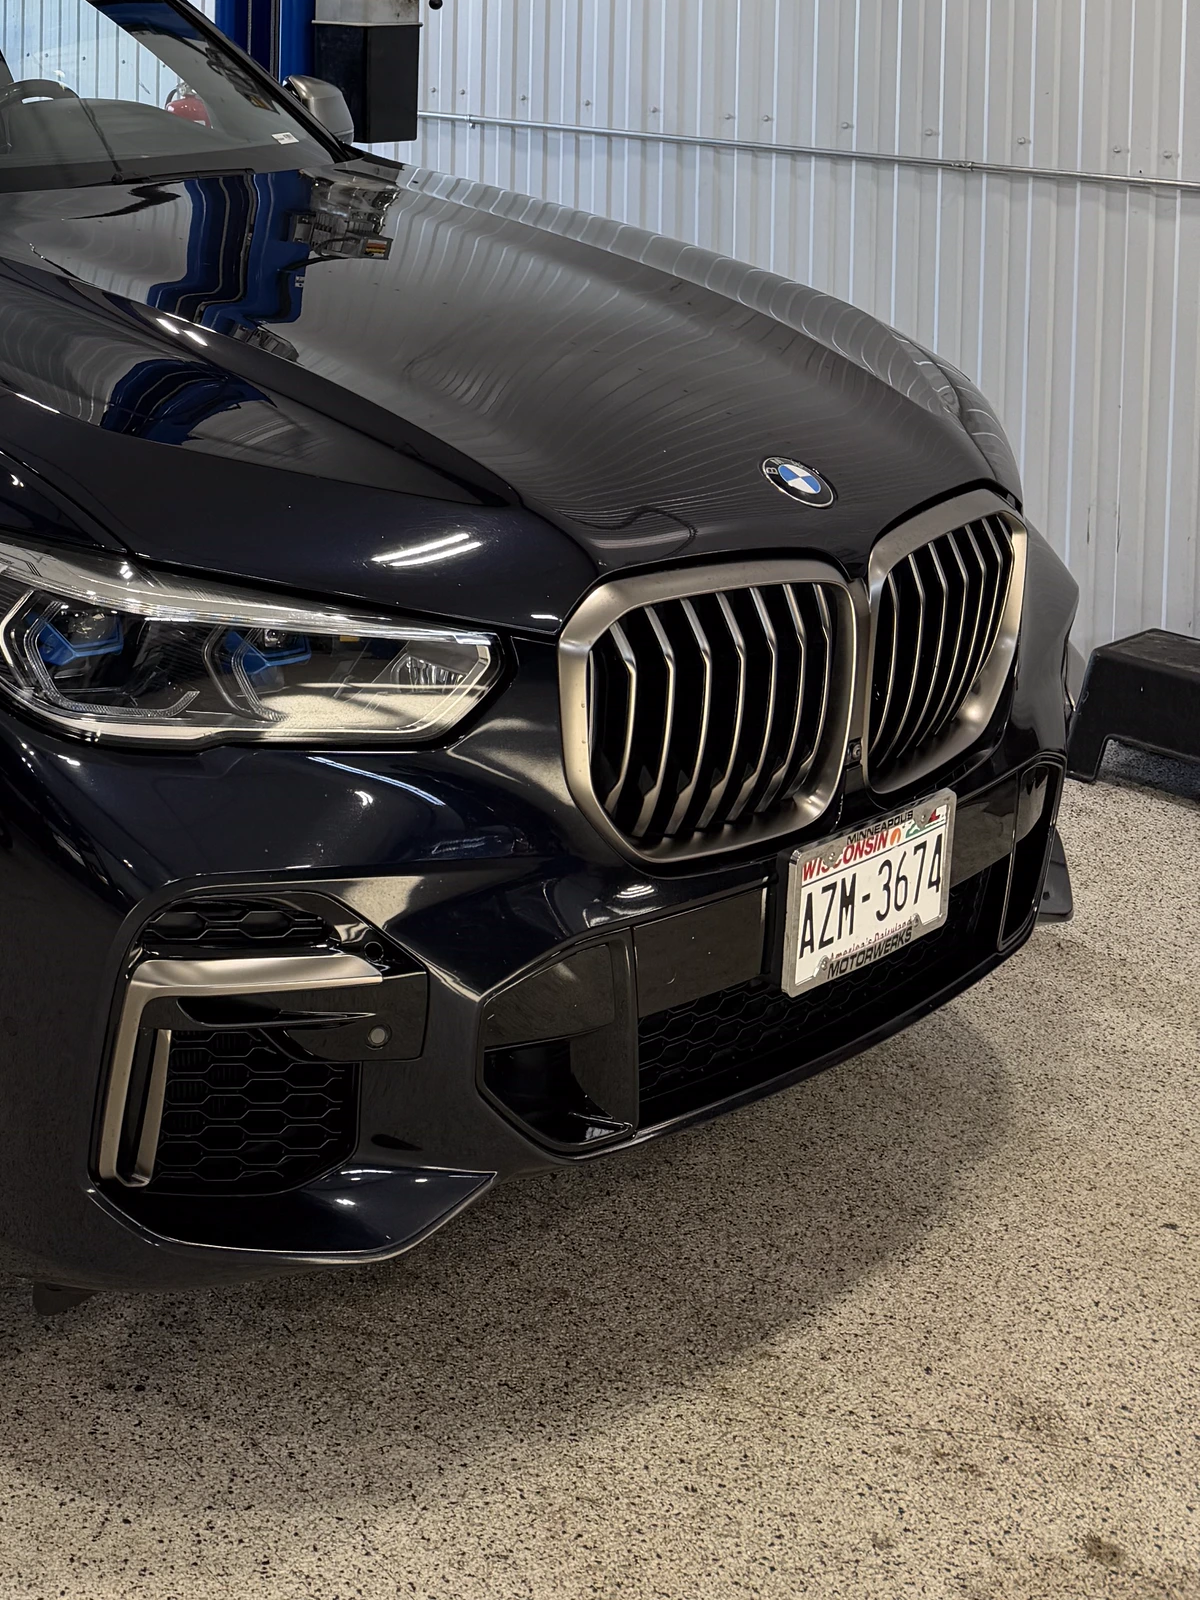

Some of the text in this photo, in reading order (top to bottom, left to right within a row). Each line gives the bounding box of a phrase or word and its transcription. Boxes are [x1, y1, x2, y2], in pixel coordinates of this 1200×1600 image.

[846, 810, 914, 845] MINNEAPOLIS
[798, 833, 943, 959] AZM-3674
[826, 926, 913, 980] MOTORWERKS
